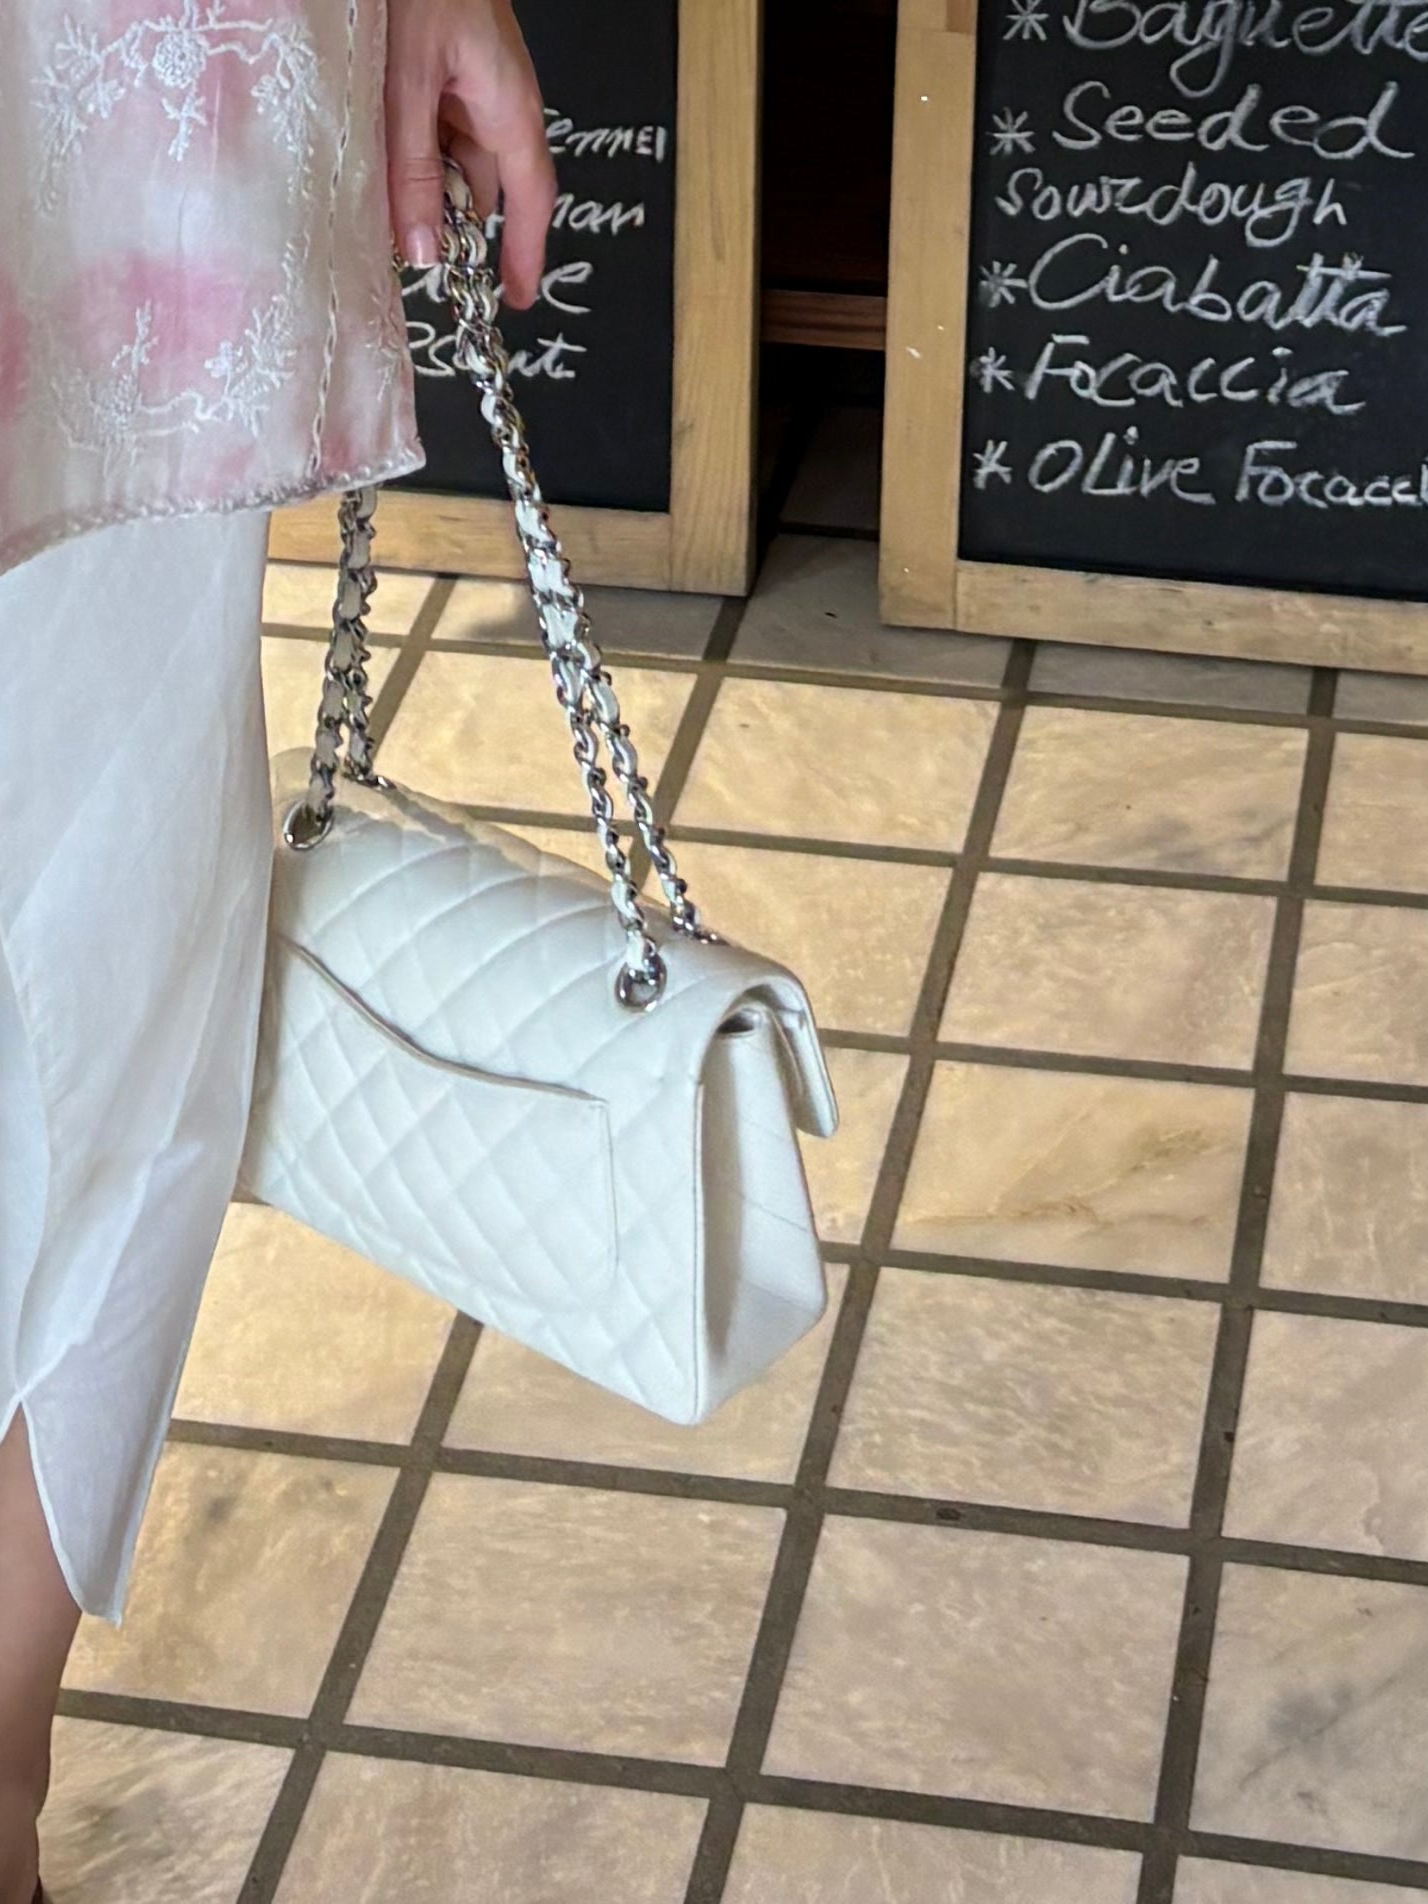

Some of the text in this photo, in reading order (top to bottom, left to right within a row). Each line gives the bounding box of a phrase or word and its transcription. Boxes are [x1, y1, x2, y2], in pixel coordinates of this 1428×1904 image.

[1052, 80, 1415, 160] Seeded
[1027, 233, 1408, 337] Ciabatta
[1024, 334, 1367, 411] Focaccia
